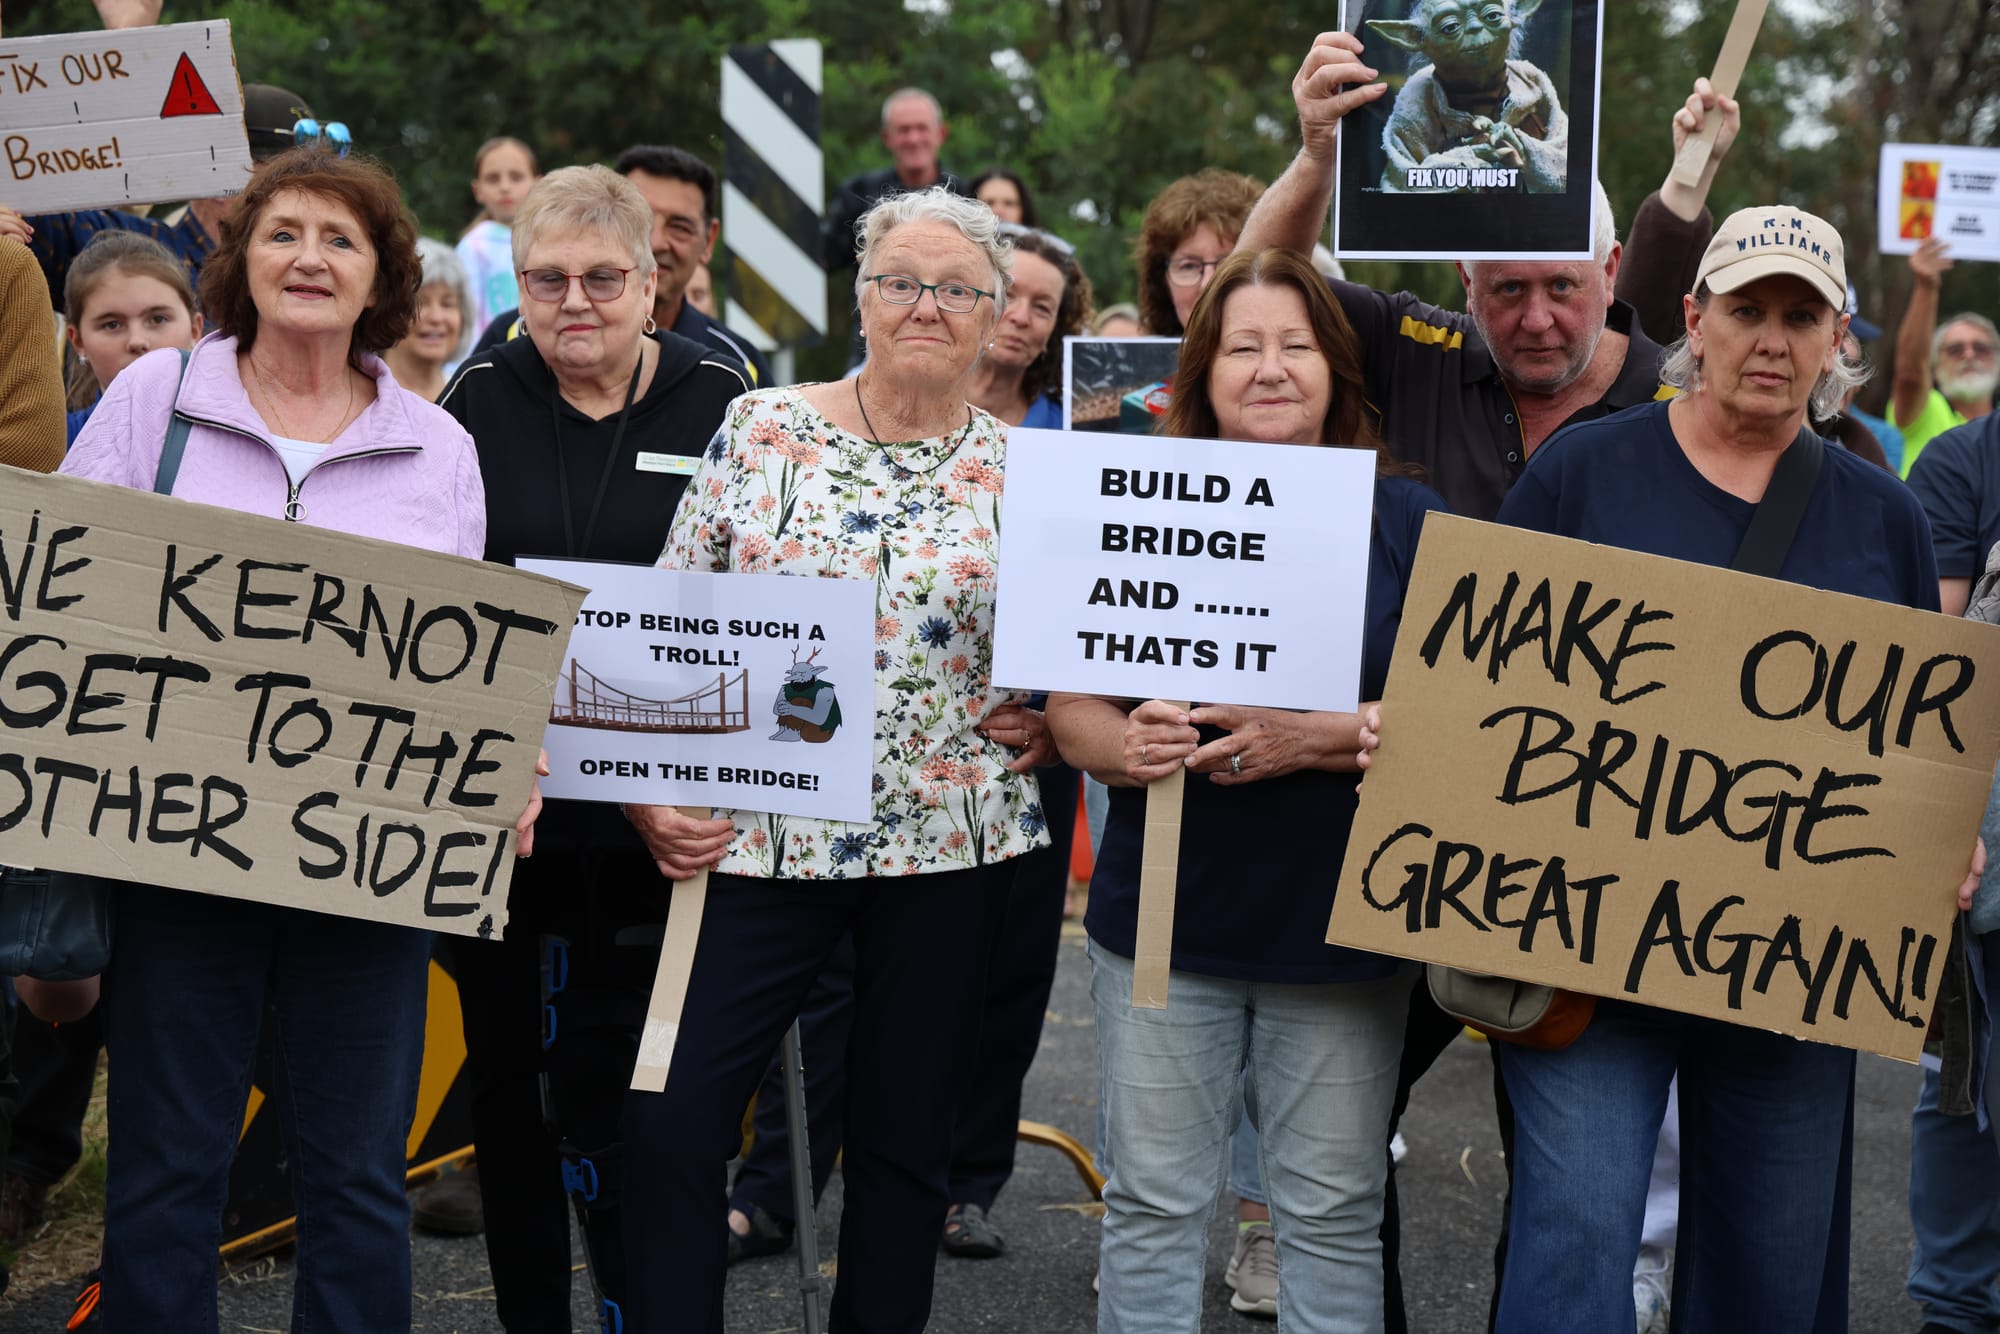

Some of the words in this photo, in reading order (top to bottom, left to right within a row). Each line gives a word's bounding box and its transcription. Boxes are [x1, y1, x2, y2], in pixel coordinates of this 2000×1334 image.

[61, 49, 130, 86] OUR
[3, 135, 123, 181] BRIDGE!
[1407, 168, 1433, 187] FIX
[1436, 168, 1469, 187] YOU
[1471, 168, 1519, 187] MUST
[1736, 232, 1831, 265] WILLIAMS
[1100, 468, 1231, 503] BUILD
[1244, 478, 1274, 507] A
[1101, 523, 1266, 562] BRIDGE
[1087, 577, 1179, 610] AND
[158, 544, 559, 686] KERNOT
[574, 609, 631, 628] TOP
[640, 613, 719, 635] BEING
[728, 619, 799, 640] SUCH
[808, 624, 826, 641] A
[649, 645, 739, 667] TROLL!
[1077, 631, 1219, 669] THATS
[1235, 642, 1277, 672] IT
[1419, 571, 1676, 706] MAKE
[1740, 630, 1976, 759] OUR
[0, 634, 211, 743] GET
[234, 671, 333, 769] TO
[347, 701, 516, 807] THE
[579, 759, 649, 778] OPEN
[657, 763, 709, 782] THE
[717, 766, 819, 792] BRIDGE!
[1479, 706, 1897, 871] BRIDGE
[291, 791, 509, 940] SIDE!
[1361, 822, 1620, 965] GREAT
[1624, 879, 1938, 1028] AGAIN!
